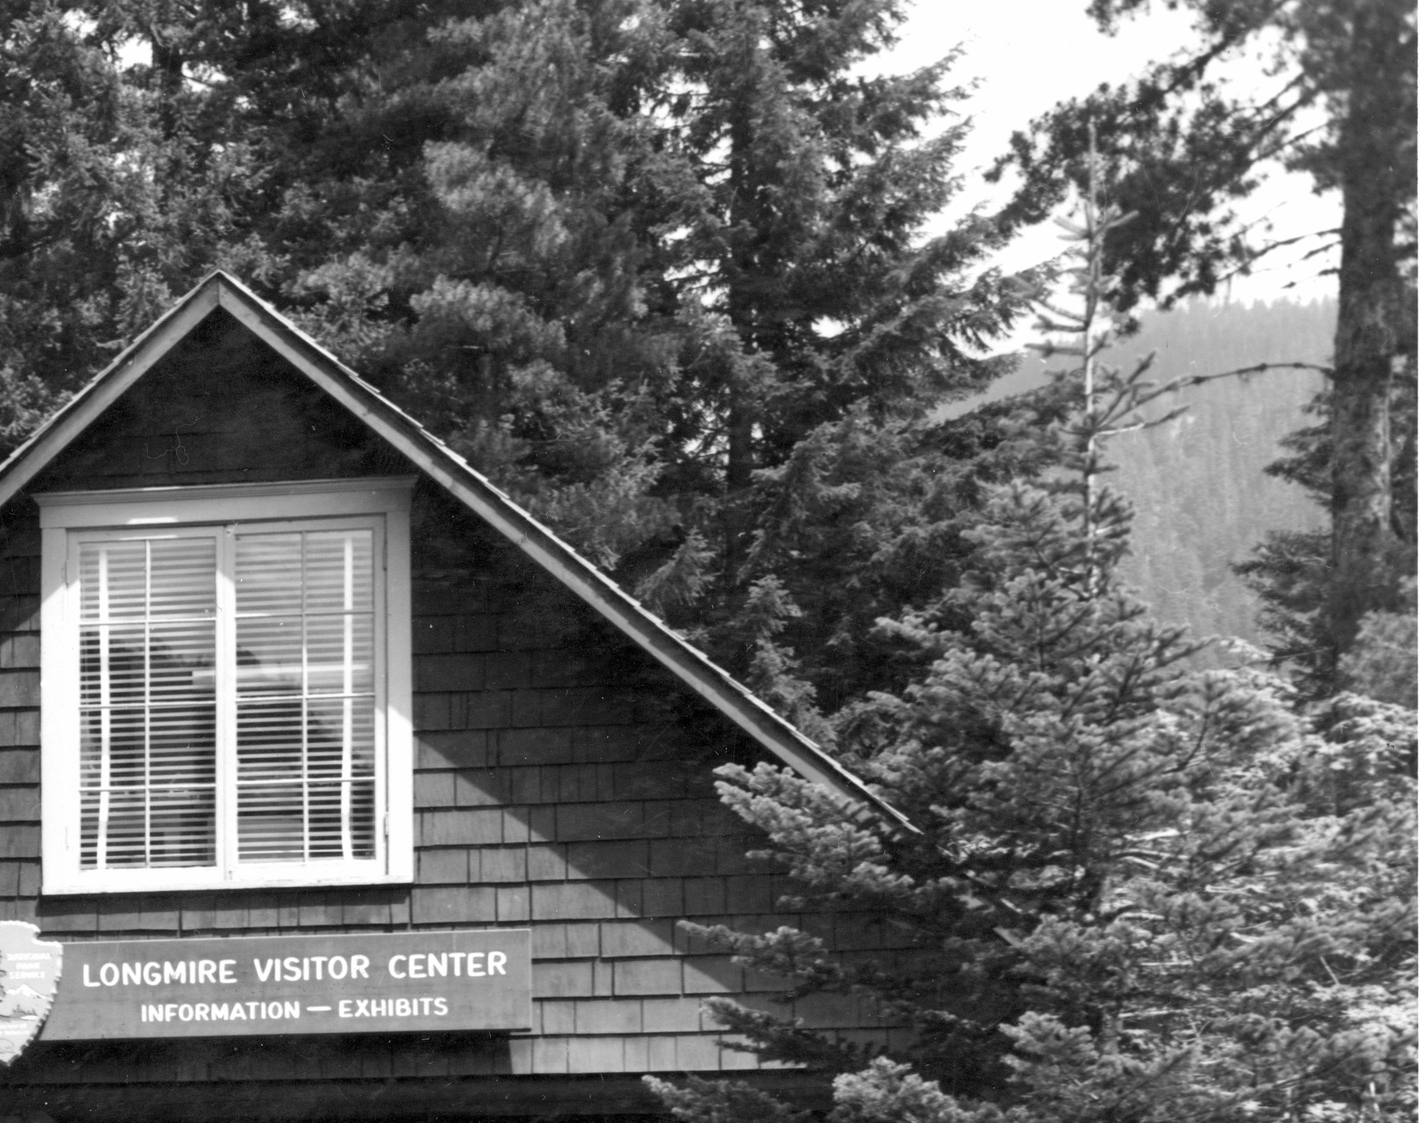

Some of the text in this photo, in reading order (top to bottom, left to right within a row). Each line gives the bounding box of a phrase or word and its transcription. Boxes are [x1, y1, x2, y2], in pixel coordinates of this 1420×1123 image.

[82, 950, 509, 988] LONGMIRE VISITOR CENTER
[140, 1000, 302, 1023] INFORMATION
[338, 997, 449, 1018] EXHIBITS
